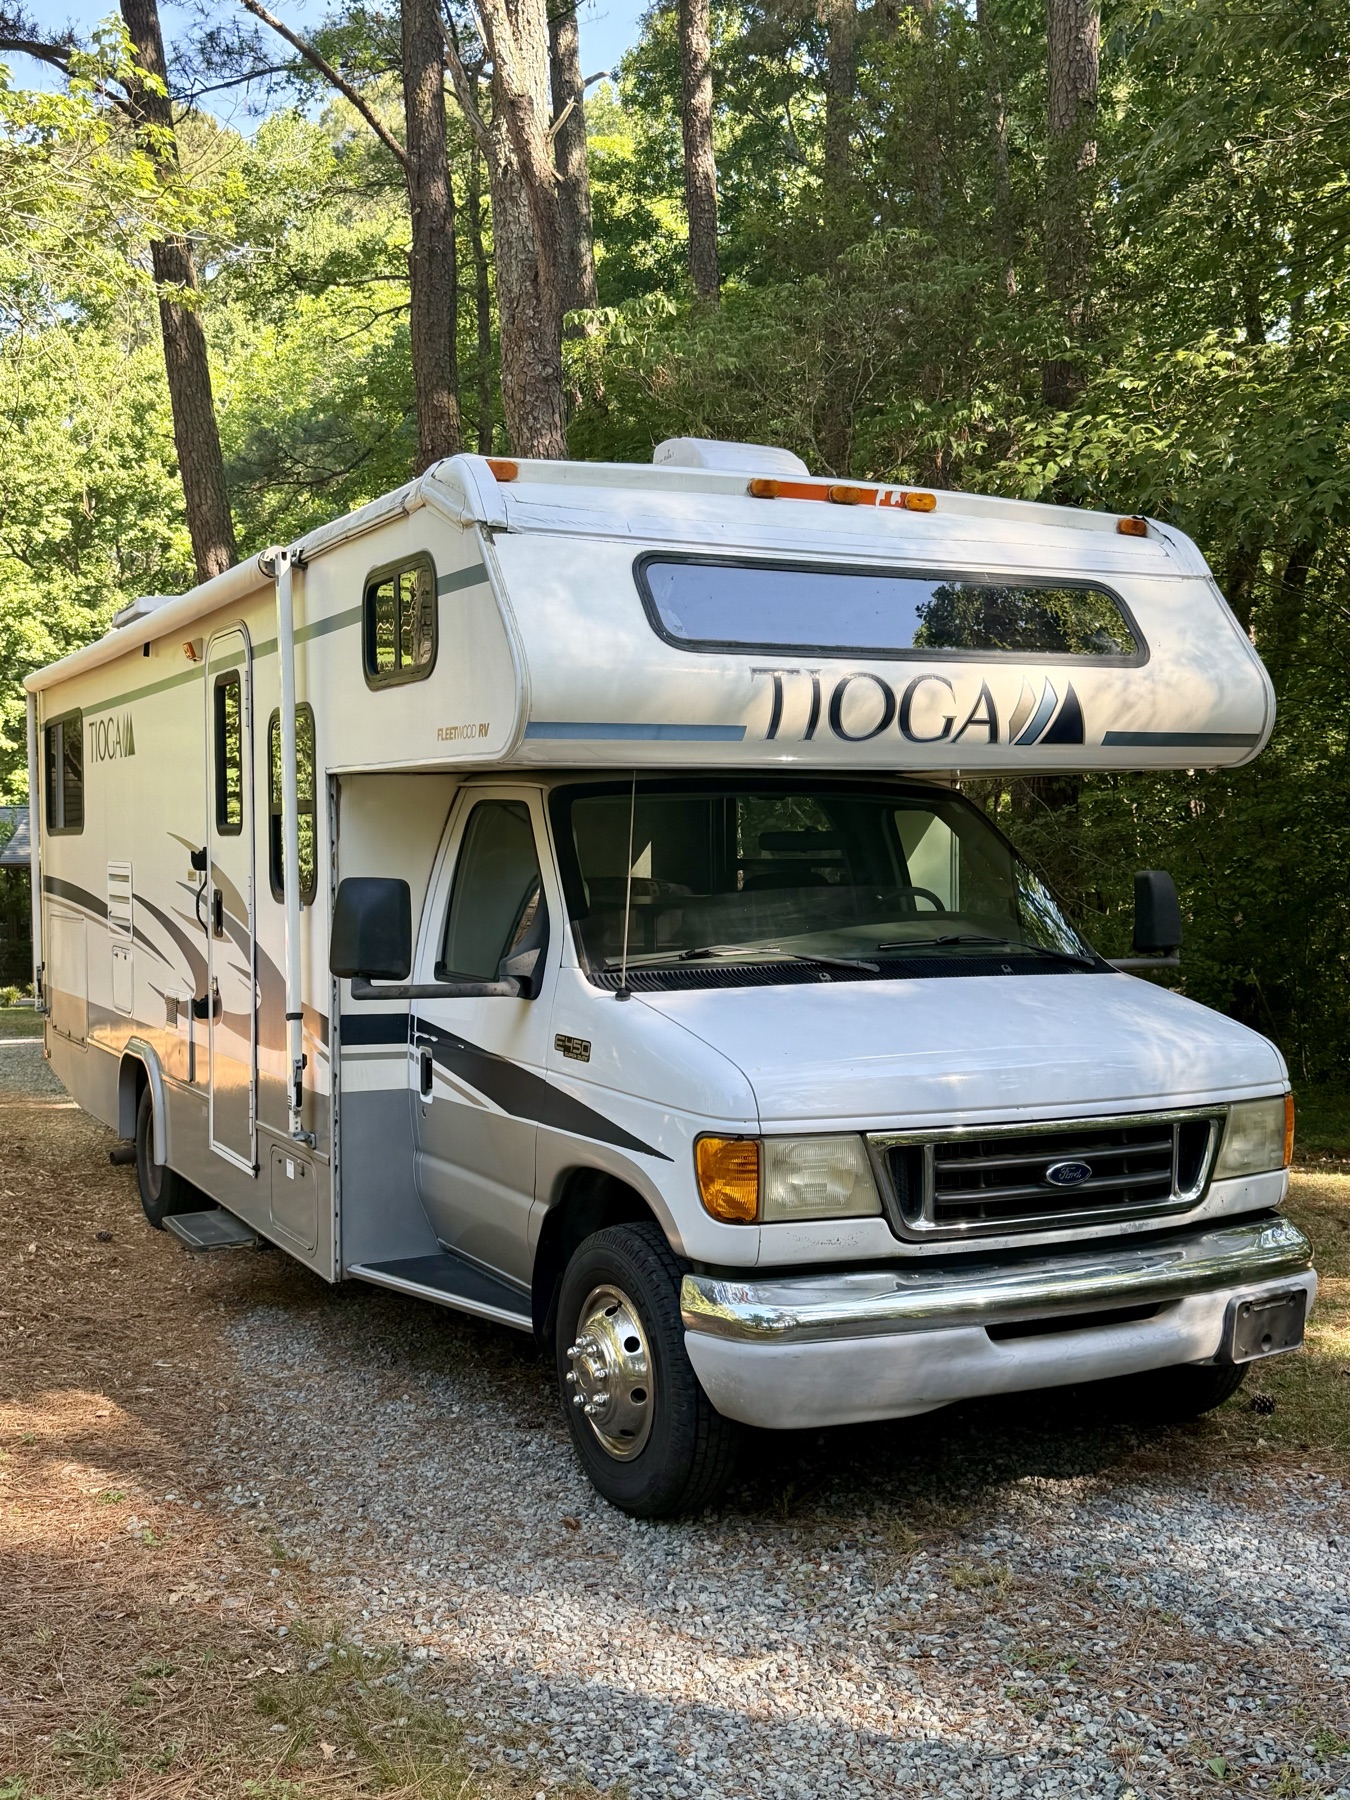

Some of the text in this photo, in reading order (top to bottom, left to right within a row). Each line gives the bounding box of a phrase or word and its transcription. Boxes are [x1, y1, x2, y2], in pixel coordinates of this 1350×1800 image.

[750, 667, 1001, 745] TIOGA
[88, 714, 123, 763] TIOGA
[437, 722, 490, 741] FLEETWOOD RV
[1058, 1166, 1082, 1180] Ford
